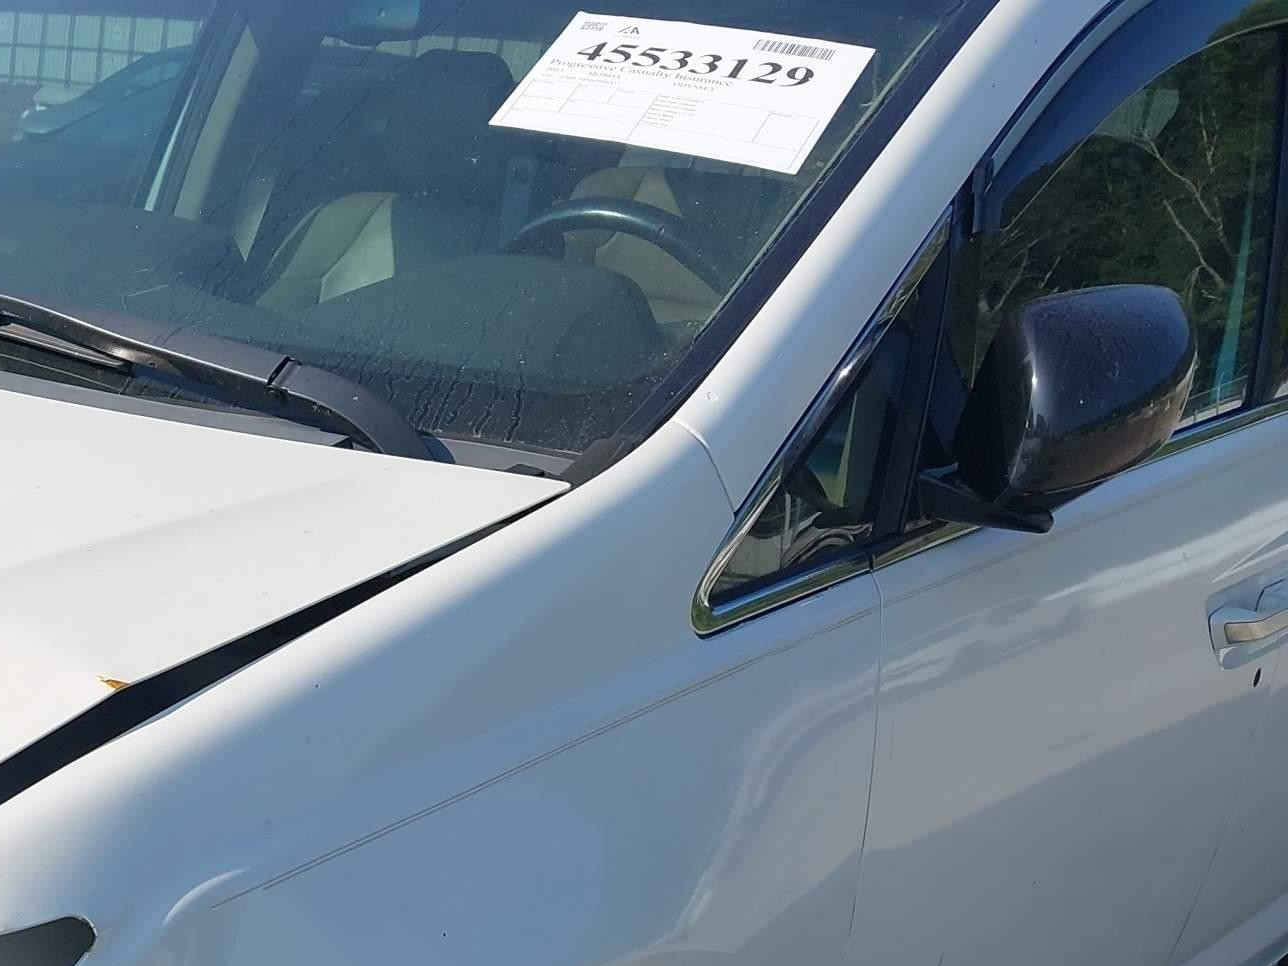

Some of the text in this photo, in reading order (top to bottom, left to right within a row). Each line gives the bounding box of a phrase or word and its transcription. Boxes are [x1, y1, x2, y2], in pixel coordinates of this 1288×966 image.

[550, 58, 733, 87] Progressive Casualty Insurance
[577, 41, 815, 87] 45533129
